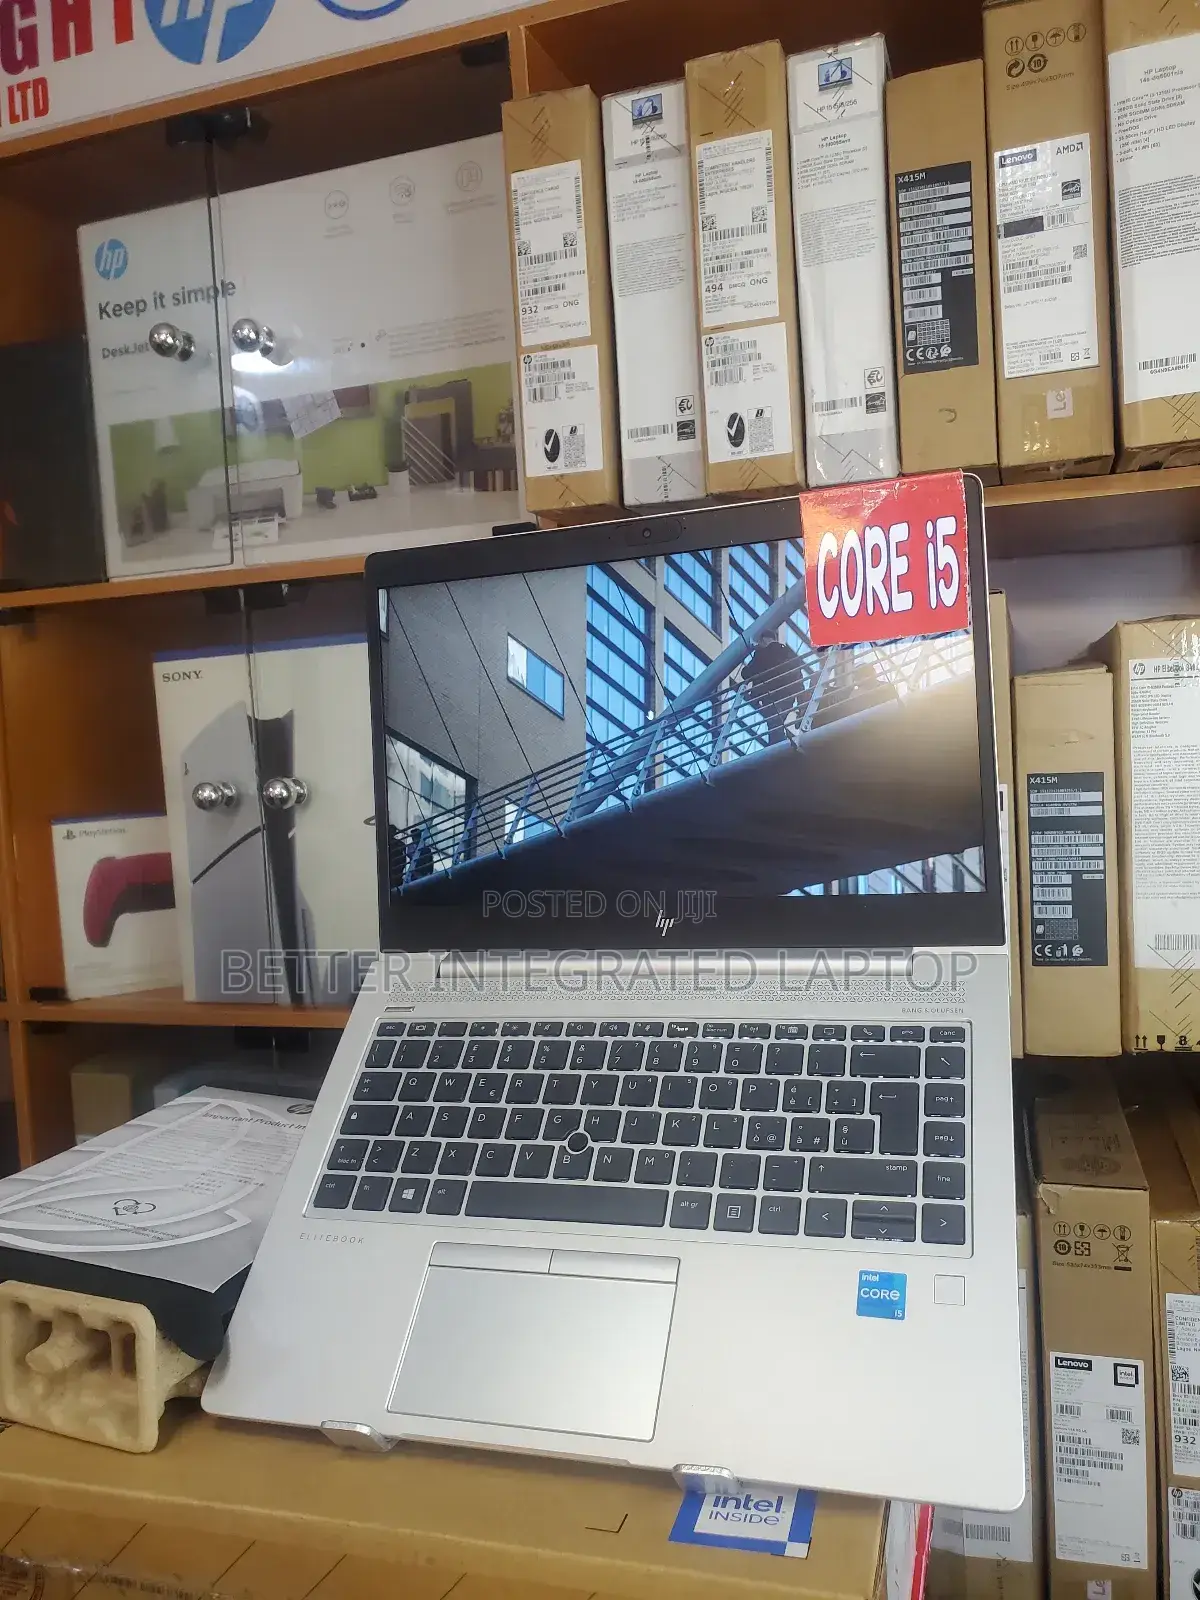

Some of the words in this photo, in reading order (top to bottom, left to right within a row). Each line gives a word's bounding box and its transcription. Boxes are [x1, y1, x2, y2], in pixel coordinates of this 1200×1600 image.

[1155, 65, 1176, 73] Laptop
[7, 76, 50, 125] LTD
[1056, 144, 1075, 155] AMD
[1001, 153, 1033, 165] Lenovo
[898, 172, 926, 183] X415M
[705, 283, 723, 293] 494
[750, 277, 768, 285] ONG
[98, 297, 147, 320] Keep
[153, 291, 166, 310] it
[172, 278, 236, 307] simple
[521, 306, 538, 315] 932
[563, 299, 579, 307] ONG
[101, 341, 150, 359] DeskJet
[816, 521, 914, 619] CORE
[925, 515, 960, 610] i5
[1154, 665, 1160, 673] HP
[162, 670, 203, 683] SONY
[433, 1055, 440, 1063] 2
[468, 1055, 475, 1063] 3
[692, 1058, 699, 1066] 9
[408, 1078, 418, 1086] Q
[445, 1078, 455, 1086] W
[478, 1078, 486, 1087] E
[591, 1080, 598, 1088] Y
[628, 1081, 637, 1089] U
[709, 1084, 718, 1092] O
[749, 1085, 756, 1093] P
[202, 1112, 253, 1123] Important
[253, 1117, 294, 1129] Product
[405, 1112, 414, 1120] A
[442, 1112, 449, 1121] S
[477, 1114, 486, 1122] D
[514, 1114, 523, 1123] F
[554, 1115, 562, 1123] G
[591, 1116, 600, 1124] H
[631, 1117, 638, 1126] J
[672, 1120, 680, 1128] K
[713, 1121, 719, 1129] L
[411, 1148, 419, 1157] Z
[448, 1149, 457, 1158] X
[486, 1151, 495, 1159] C
[525, 1151, 534, 1160] V
[563, 1155, 571, 1164] B
[602, 1155, 612, 1164] N
[644, 1157, 655, 1166] M
[299, 1232, 365, 1244] ELITEBOOK
[861, 1273, 879, 1282] intel
[894, 1309, 902, 1318] i5
[1058, 1358, 1089, 1368] Lenovo
[1175, 1435, 1196, 1445] 932
[712, 1493, 784, 1513] intel
